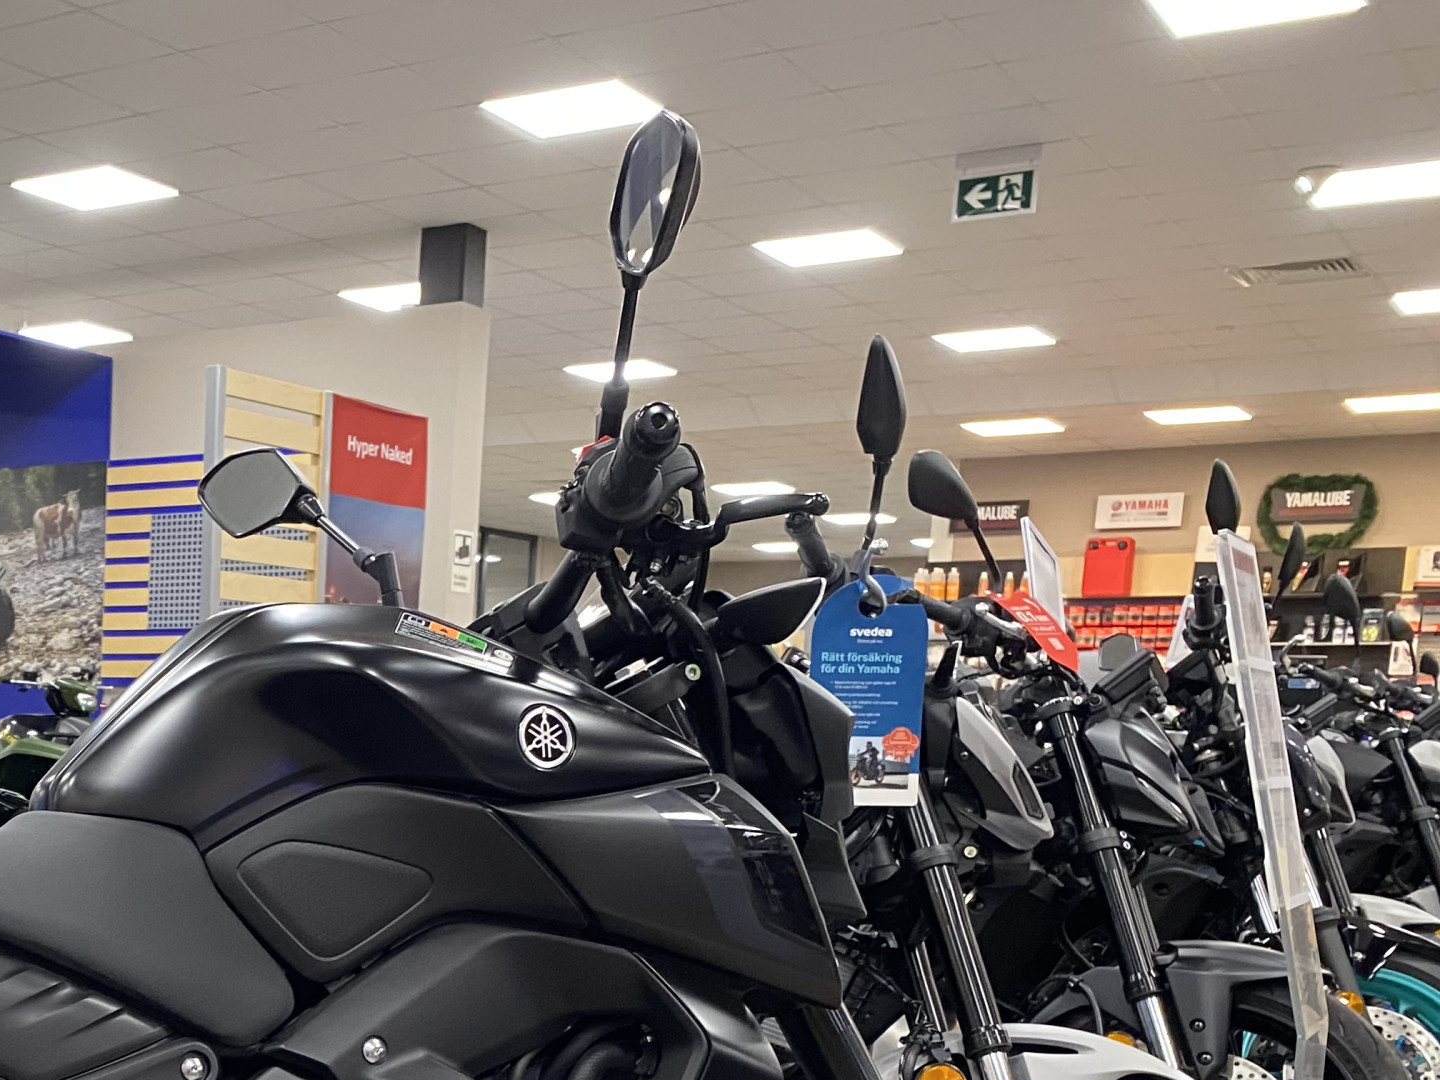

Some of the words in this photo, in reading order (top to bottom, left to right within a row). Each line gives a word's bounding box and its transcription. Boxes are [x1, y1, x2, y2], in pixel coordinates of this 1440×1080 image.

[347, 435, 380, 459] Hyper
[380, 443, 413, 466] Naked
[1124, 499, 1169, 510] YAMAHA
[1285, 490, 1352, 508] YAMALUBE
[849, 627, 893, 637] svedea
[821, 652, 845, 662] Rätt
[847, 652, 903, 664] försäkring
[821, 664, 837, 674] för
[838, 664, 855, 674] din
[857, 664, 901, 674] Yamaha
